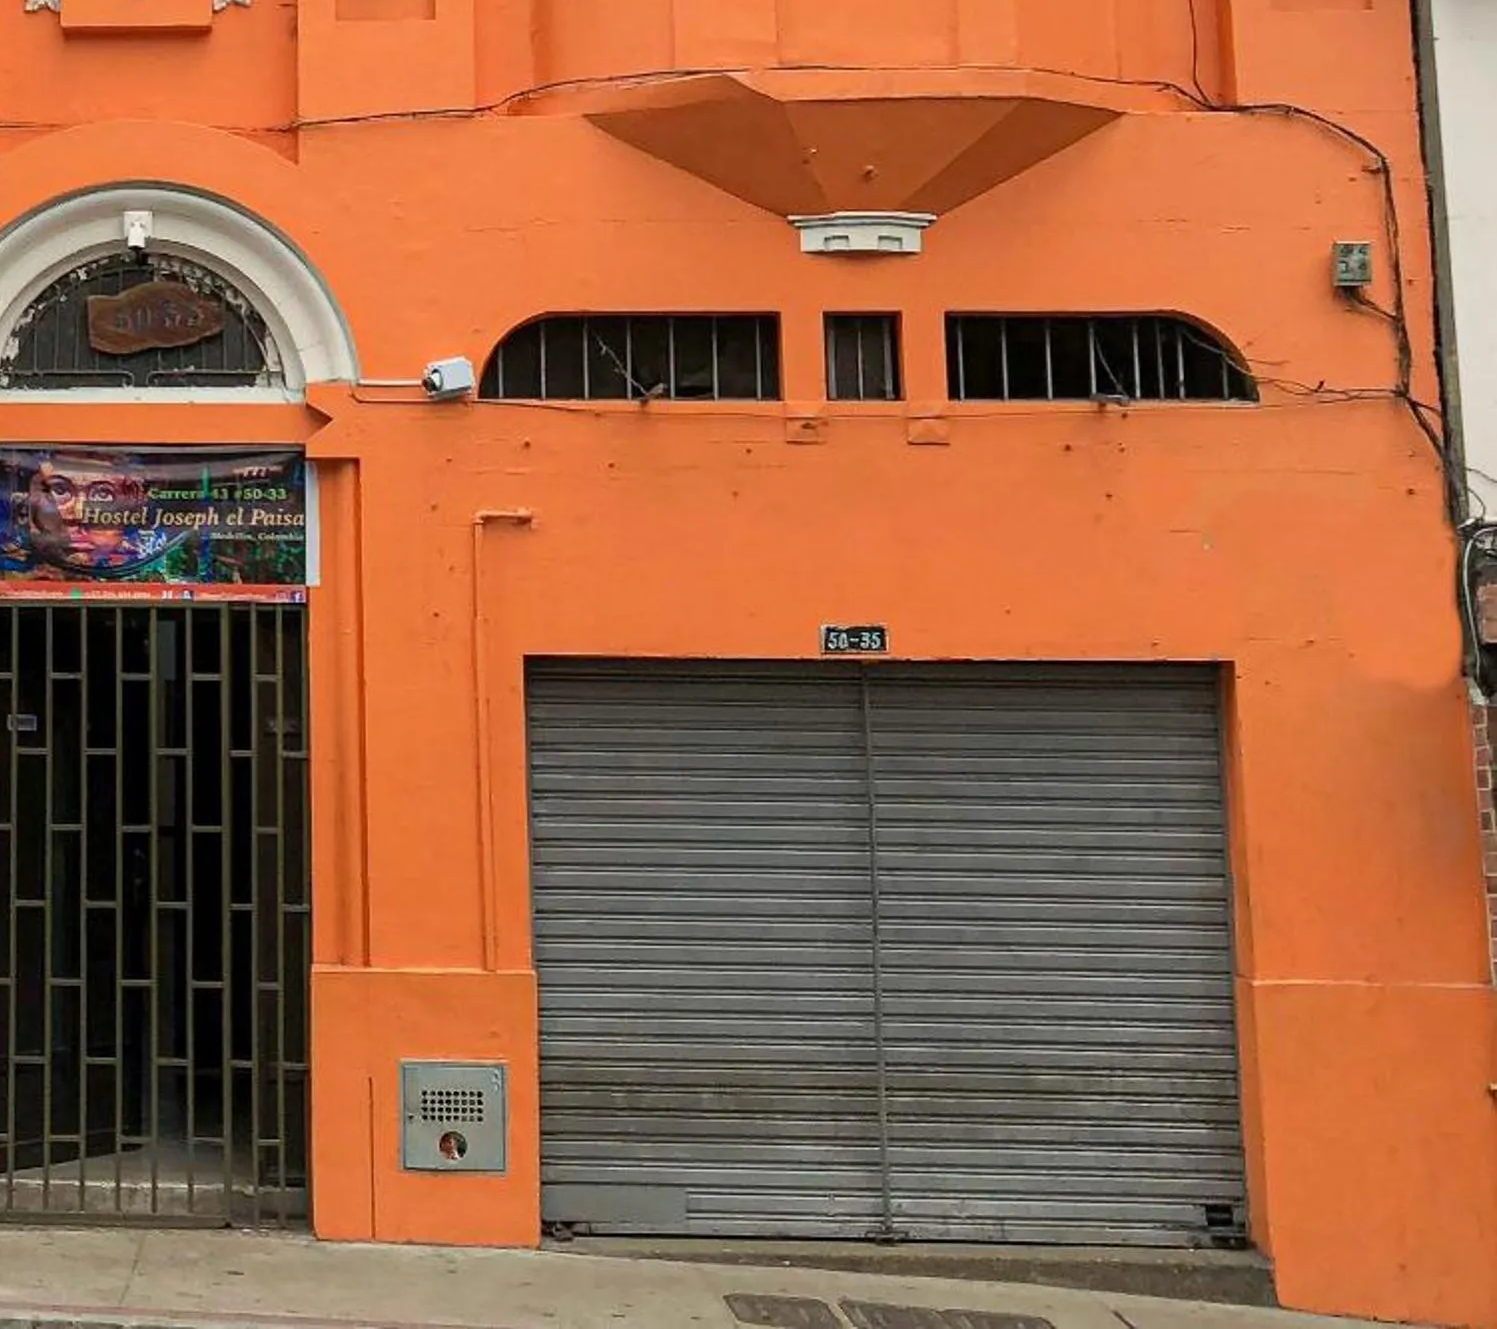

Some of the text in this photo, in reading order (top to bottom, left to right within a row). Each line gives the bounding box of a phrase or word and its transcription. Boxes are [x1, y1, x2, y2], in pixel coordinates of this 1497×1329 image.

[82, 506, 304, 531] Hostel Joseph el Paisa
